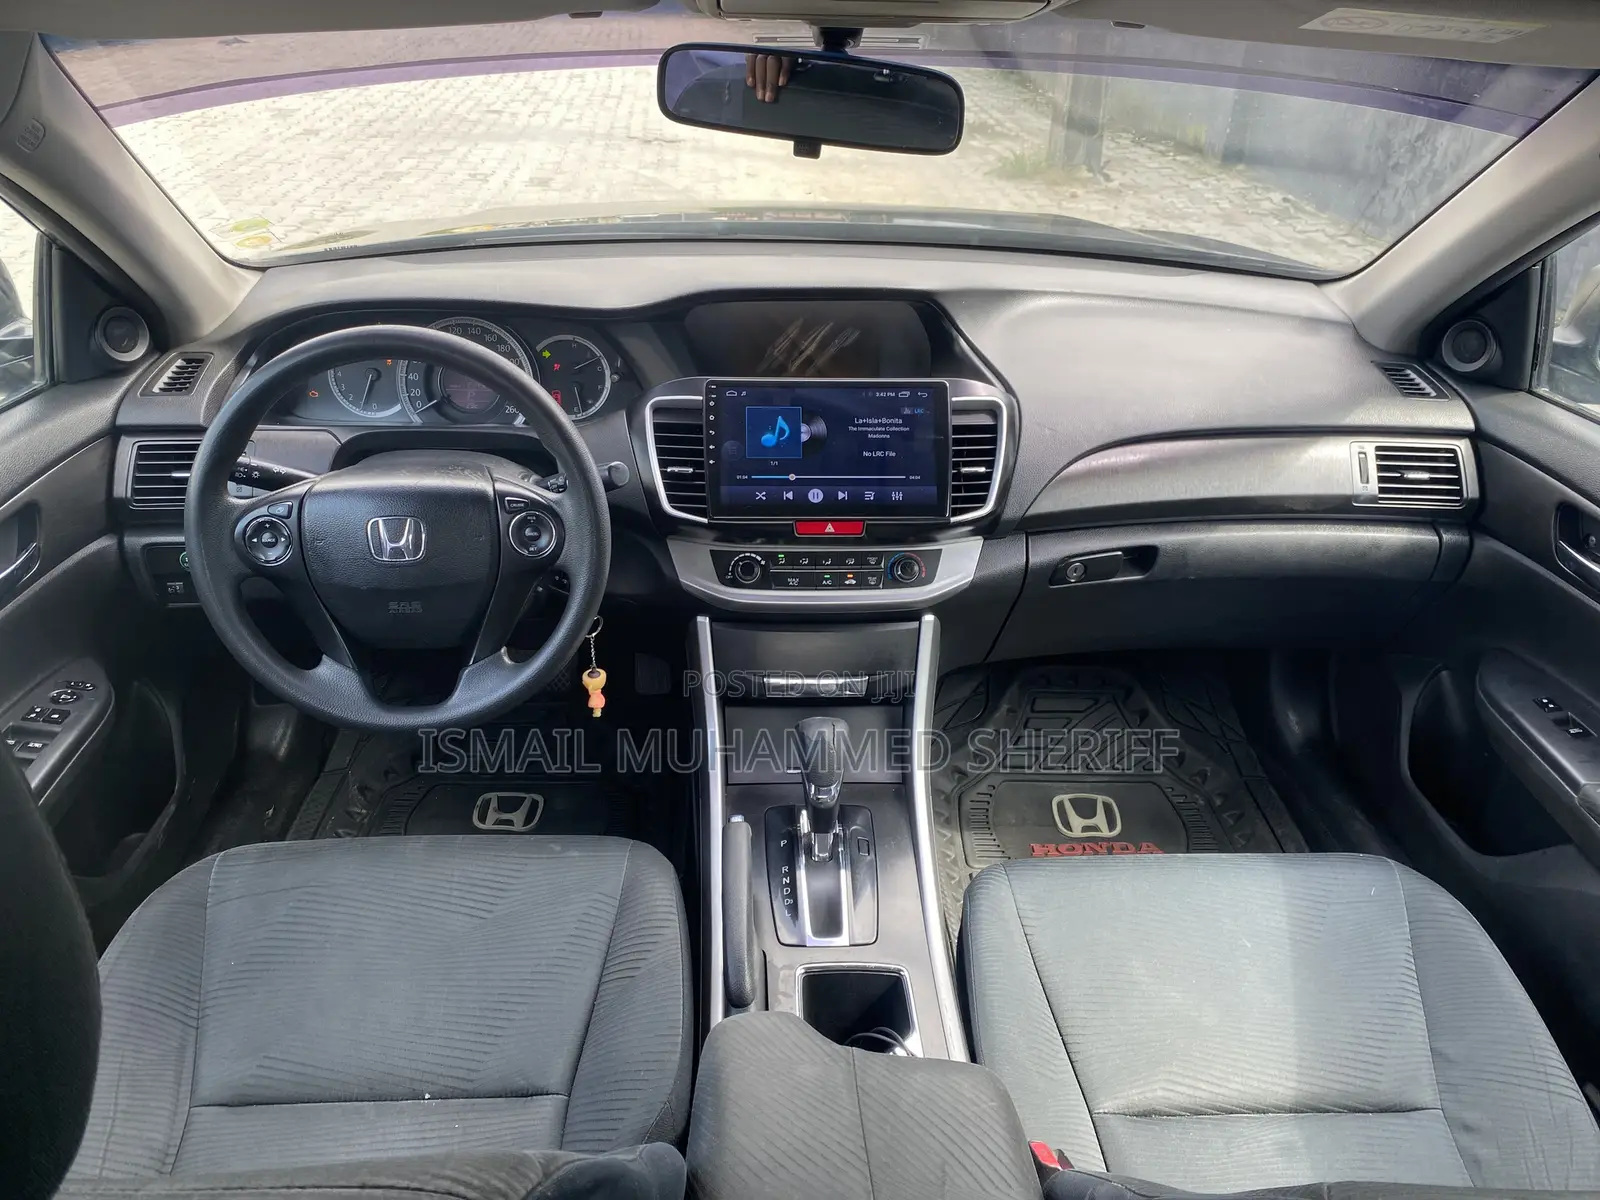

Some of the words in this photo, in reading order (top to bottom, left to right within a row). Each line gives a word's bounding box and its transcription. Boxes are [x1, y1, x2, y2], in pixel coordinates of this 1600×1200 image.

[449, 327, 462, 335] 120
[467, 327, 481, 335] 140
[484, 334, 497, 342] 160
[497, 344, 511, 352] 180
[854, 417, 903, 425] La+Isla+Bonita
[1029, 841, 1165, 857] HONDA
[783, 887, 791, 895] D
